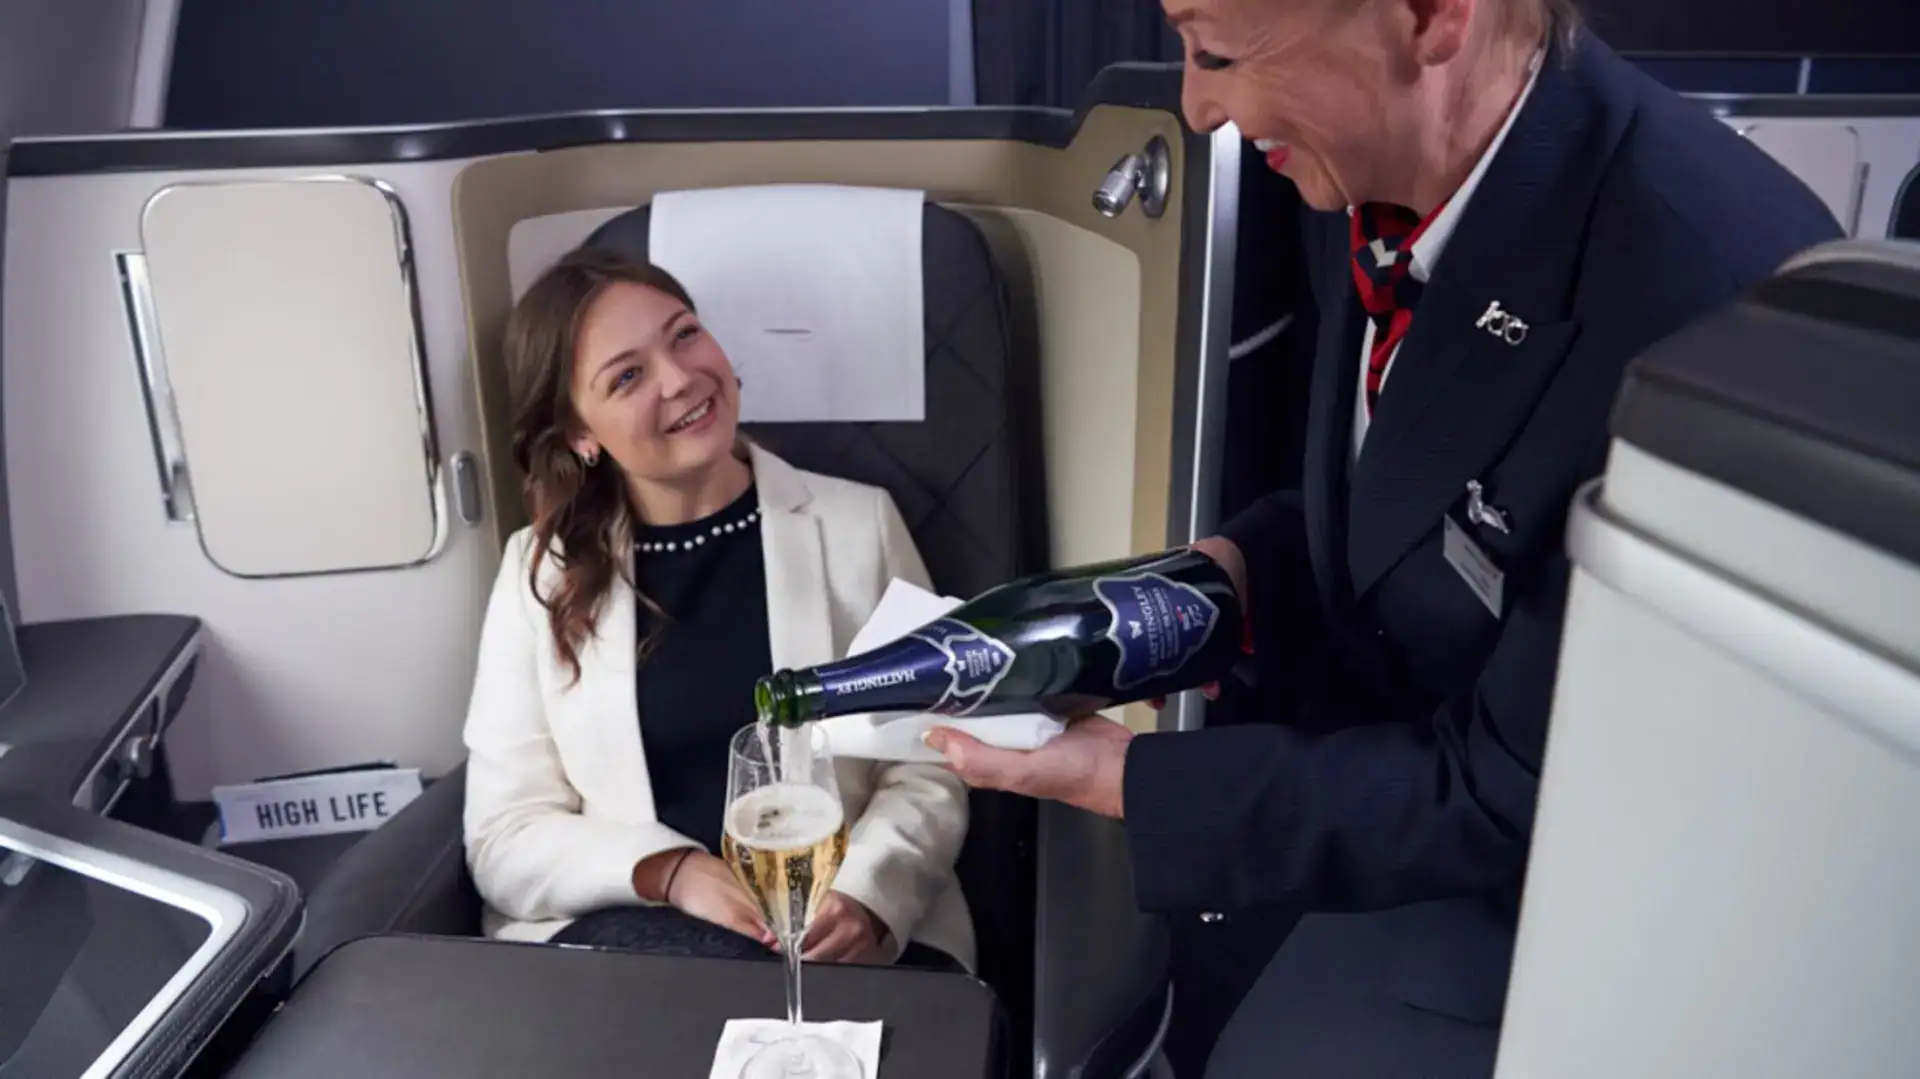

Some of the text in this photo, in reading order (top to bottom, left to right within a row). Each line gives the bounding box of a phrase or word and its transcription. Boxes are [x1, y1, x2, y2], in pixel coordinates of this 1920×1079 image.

[836, 668, 916, 696] HATTINGLEY
[256, 791, 389, 830] HIGH LIFE
